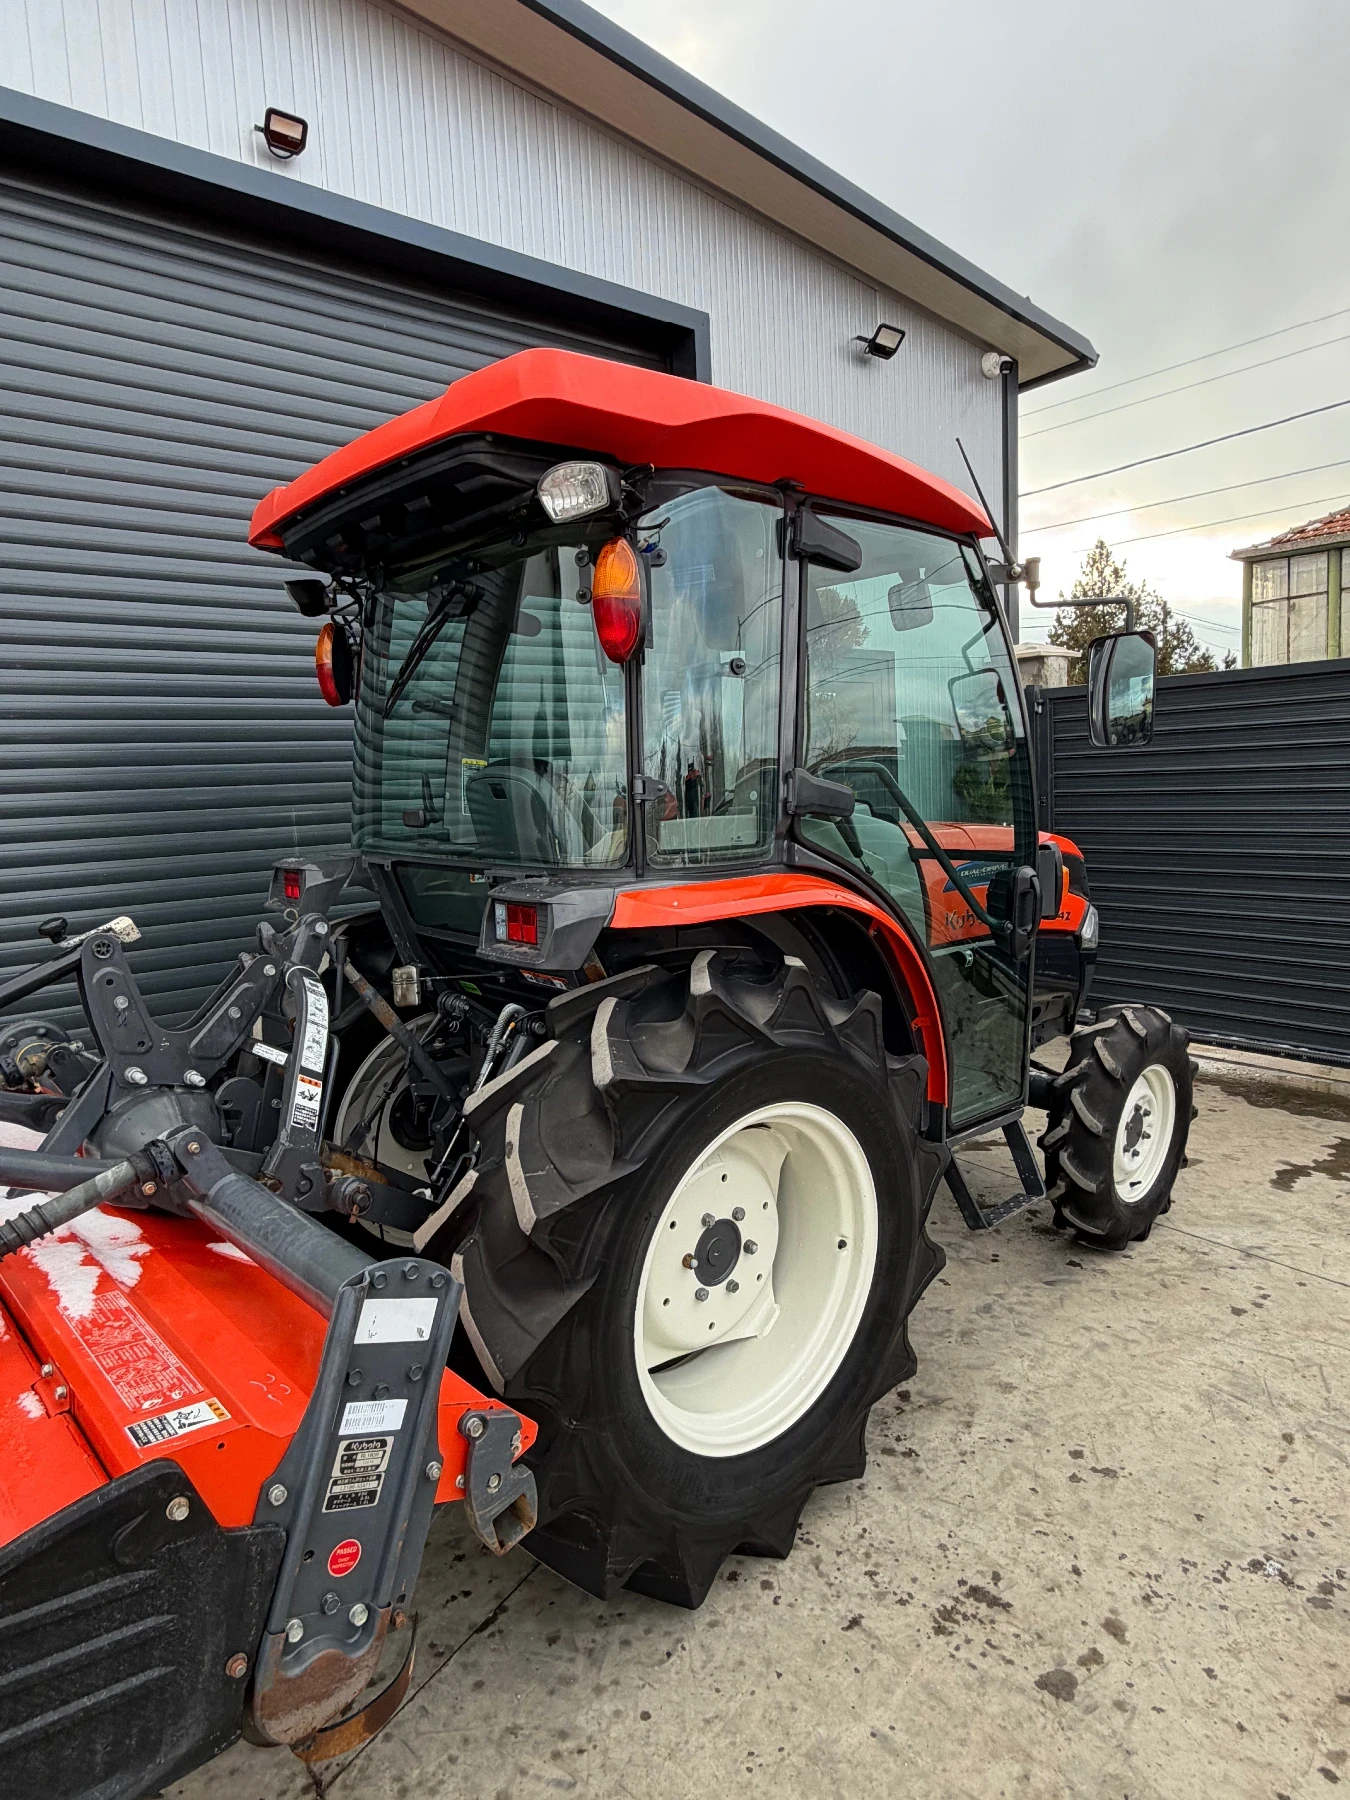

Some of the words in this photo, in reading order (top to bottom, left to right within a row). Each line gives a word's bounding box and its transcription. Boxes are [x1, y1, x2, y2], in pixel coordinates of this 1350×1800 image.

[945, 908, 976, 930] Kub
[350, 1440, 381, 1451] Kubota
[336, 1546, 358, 1556] PASSED
